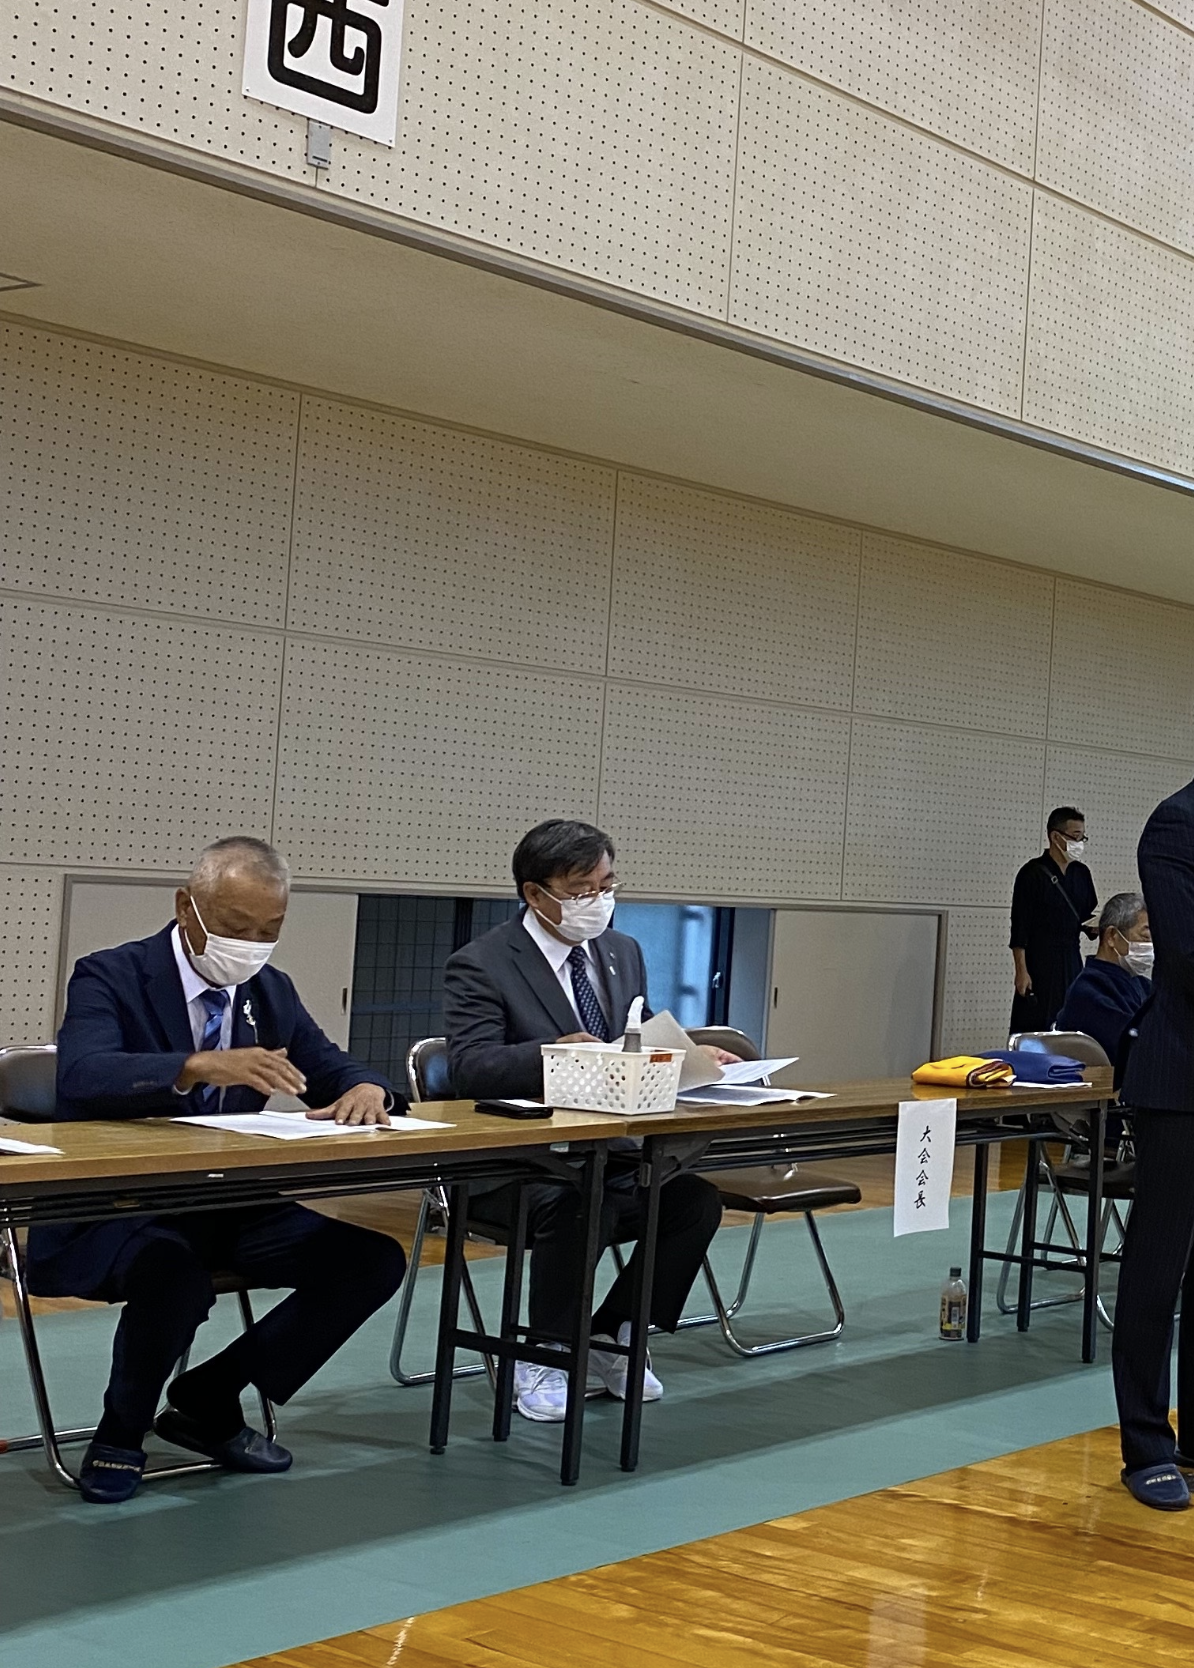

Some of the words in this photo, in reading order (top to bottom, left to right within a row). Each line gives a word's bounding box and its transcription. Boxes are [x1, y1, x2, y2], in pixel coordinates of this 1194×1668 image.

[267, 0, 389, 114] 西
[914, 1125, 931, 1209] 大会会長
